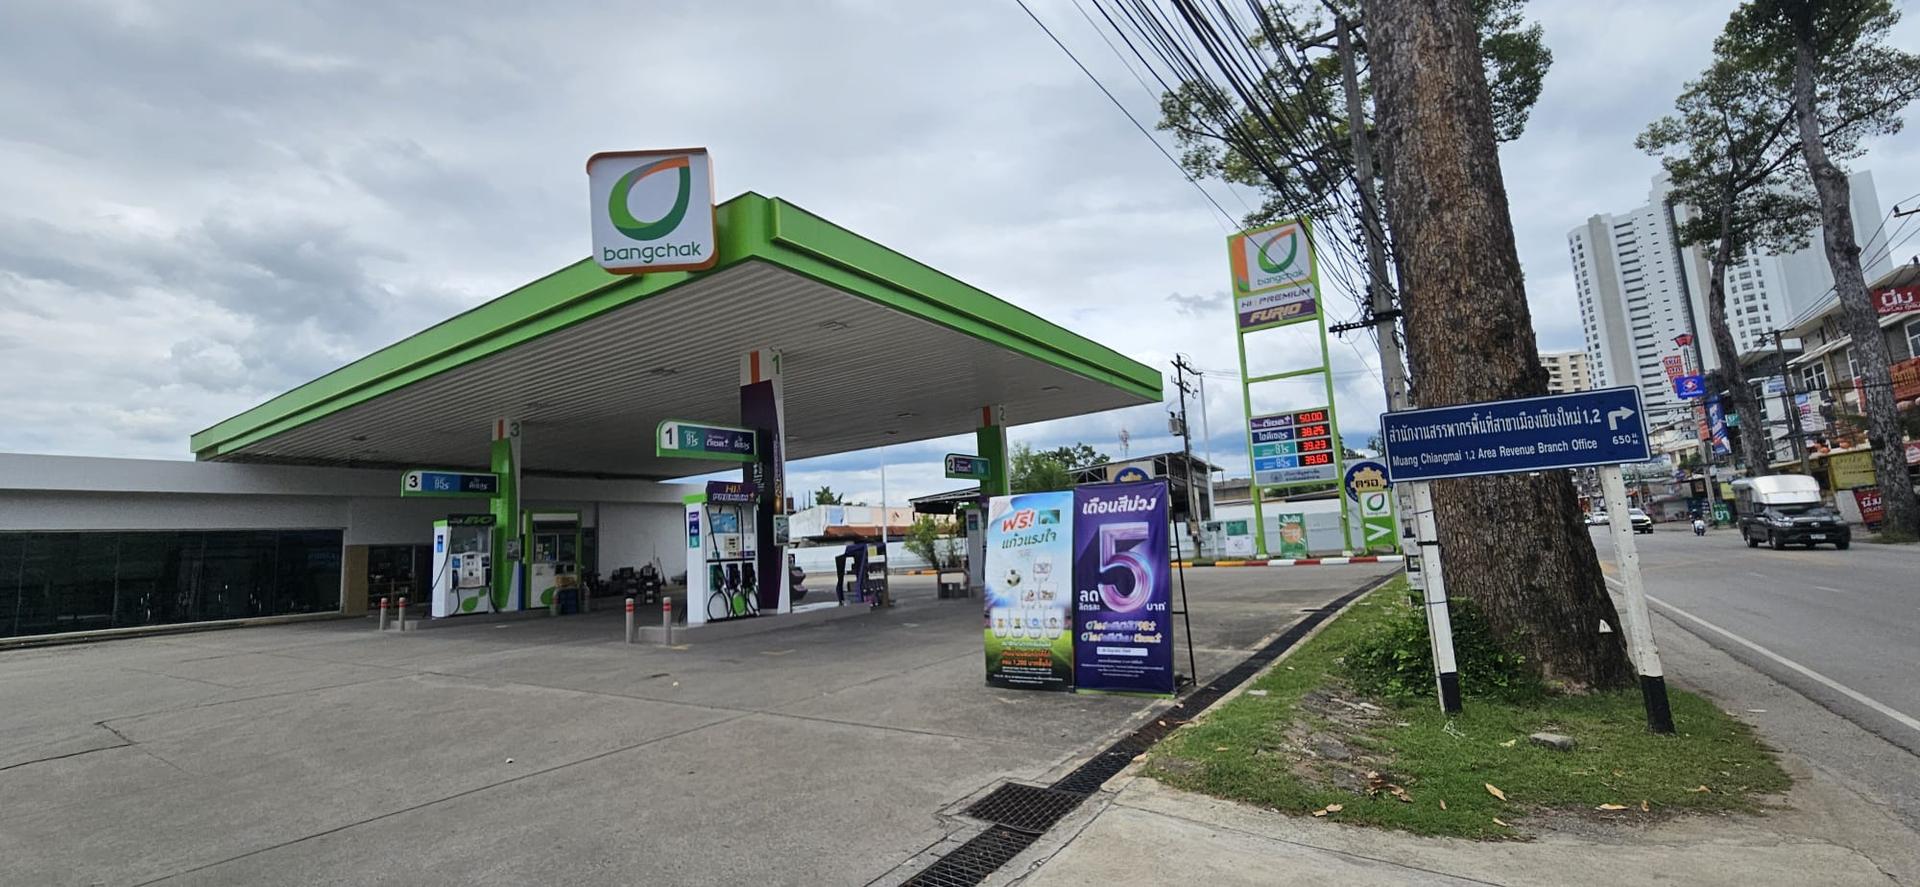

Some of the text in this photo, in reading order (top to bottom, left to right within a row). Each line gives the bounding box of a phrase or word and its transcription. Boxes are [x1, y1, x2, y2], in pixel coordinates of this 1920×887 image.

[603, 241, 702, 264] bangchak
[1257, 269, 1304, 286] bangchak
[1241, 287, 1311, 308] HI PREMIUM
[1249, 302, 1302, 323] FURIO
[772, 354, 780, 375] 1
[1299, 411, 1323, 423] 50.00
[1389, 406, 1602, 443] สำนักงานสรรพากรพื้นที่สาขาเมืองเชียงใหม่ 1,2
[510, 422, 520, 437] 3
[665, 427, 674, 446] 1
[1301, 425, 1325, 437] 38.25
[1303, 439, 1327, 451] 39.23
[1612, 434, 1631, 445] 650
[1305, 453, 1328, 465] 39.60
[1392, 438, 1598, 468] Muang Chiangmai 1,2 Area Revenue Branch Office
[948, 459, 953, 471] 2
[409, 475, 418, 488] 3
[1082, 494, 1157, 515] เดือนสีม่วง
[1001, 527, 1057, 549] แก้วแรงใจ
[1098, 521, 1154, 613] 5
[1079, 589, 1099, 602] ลด
